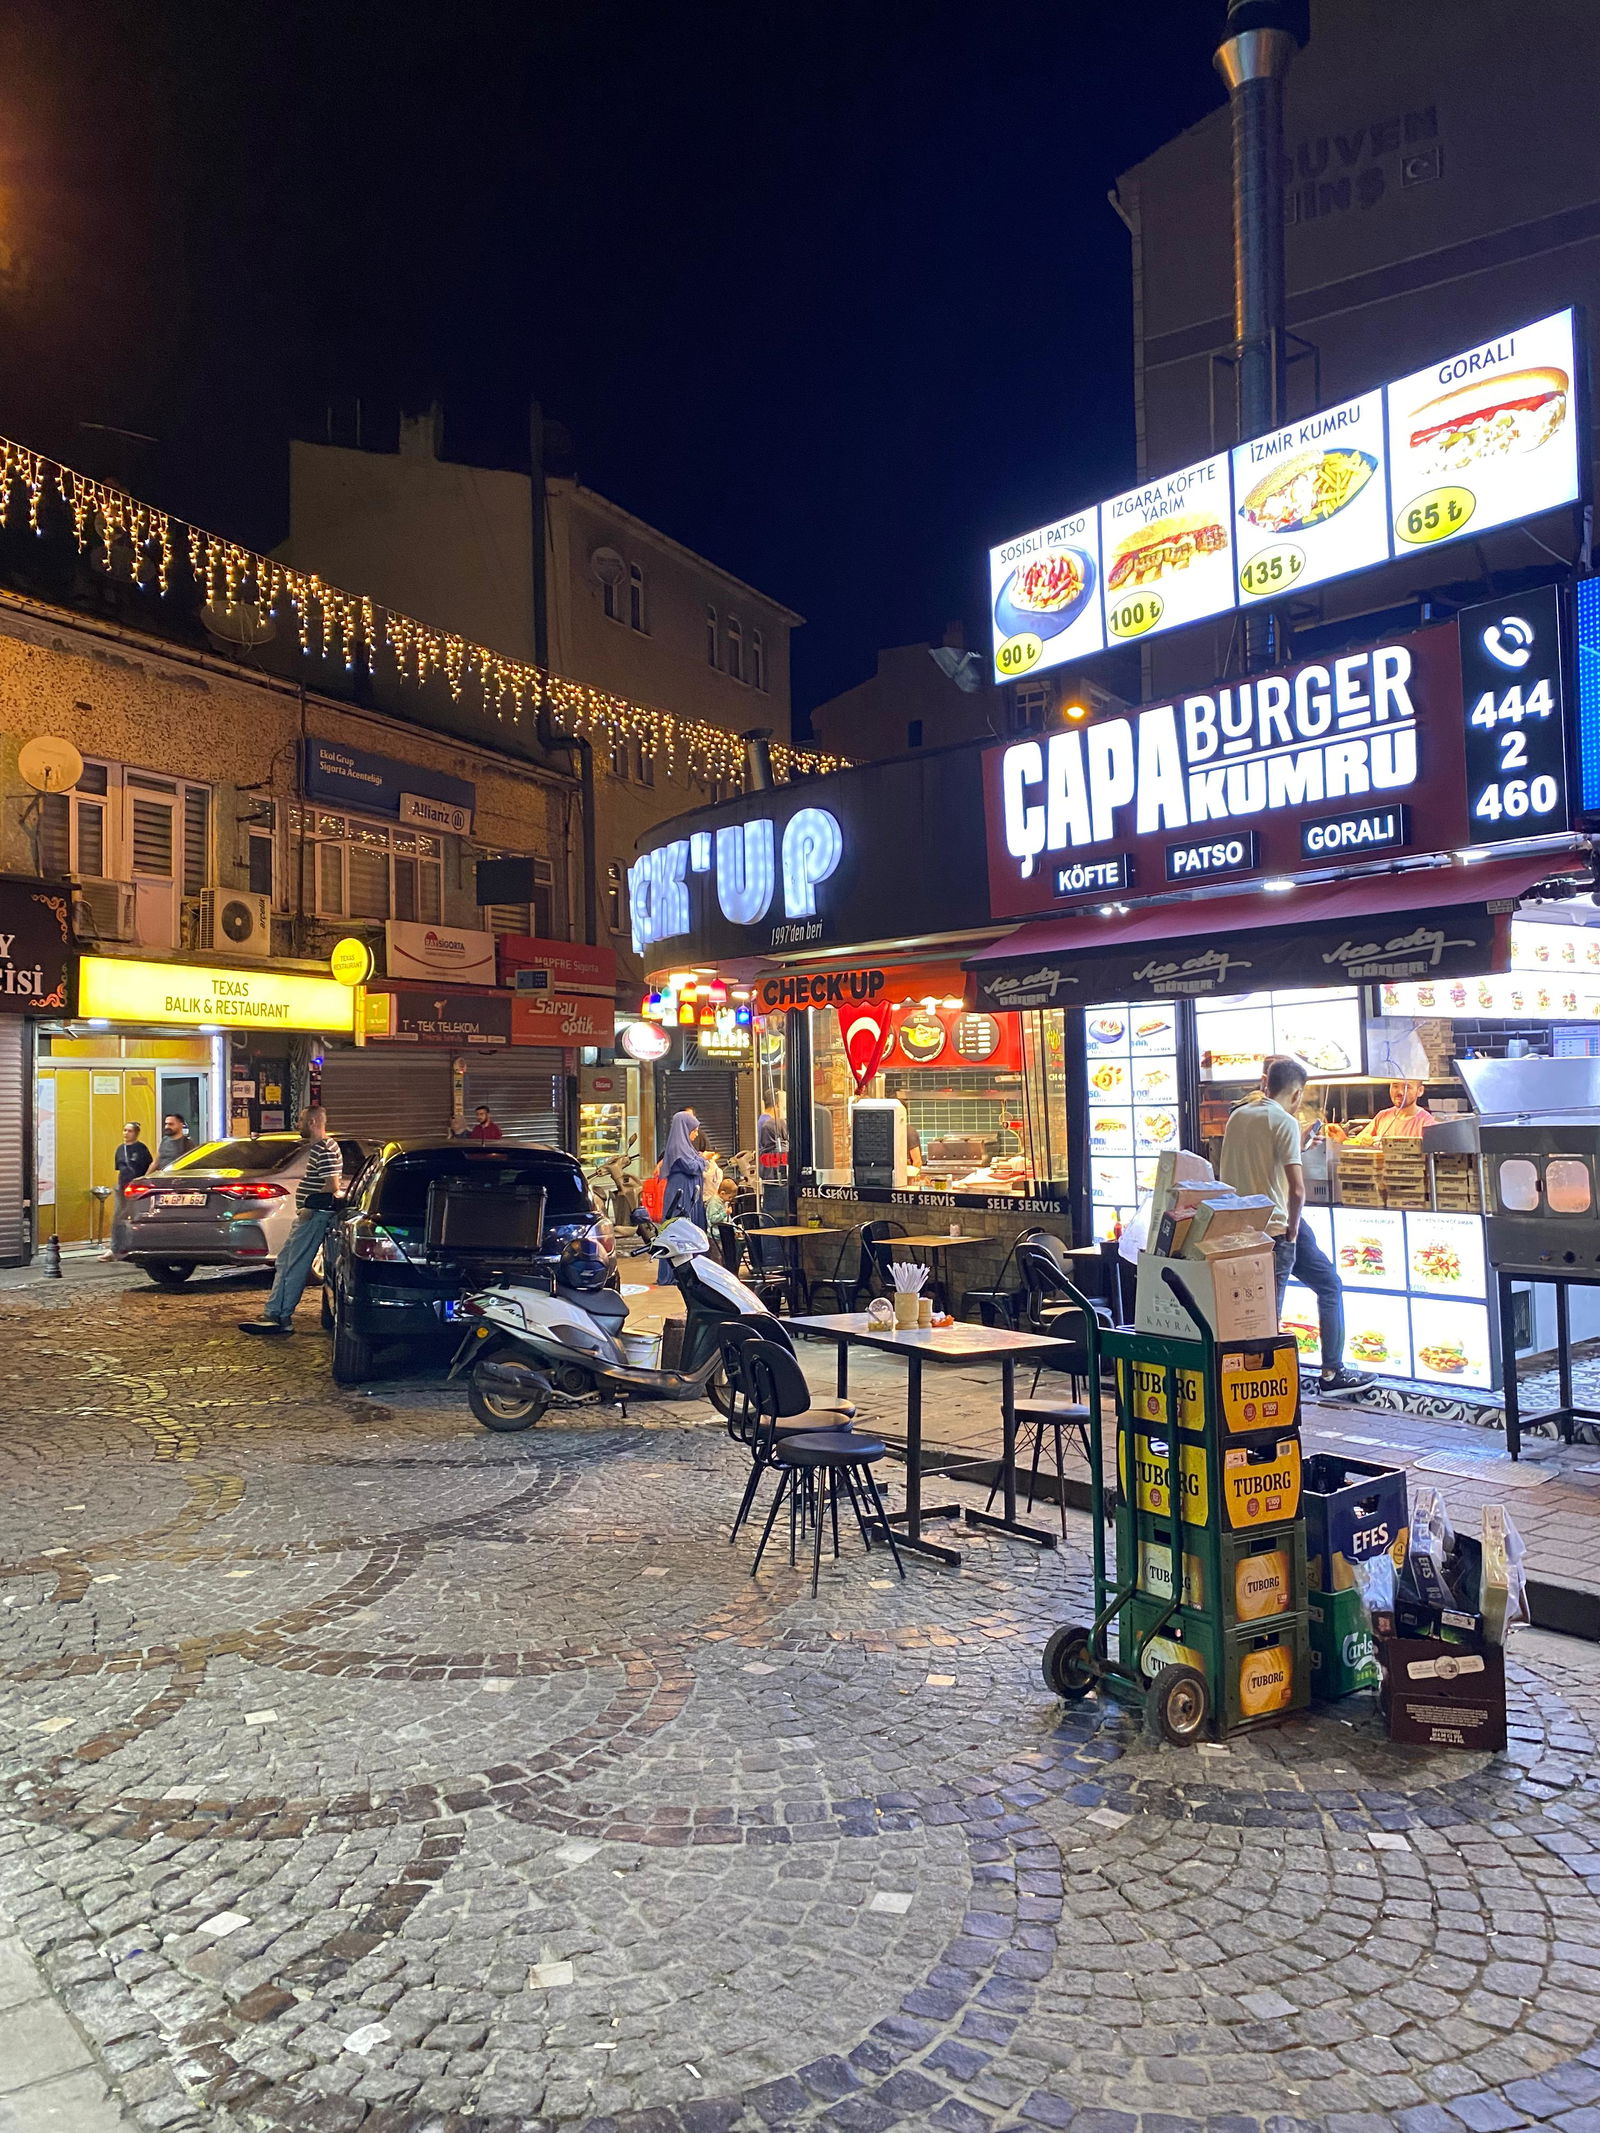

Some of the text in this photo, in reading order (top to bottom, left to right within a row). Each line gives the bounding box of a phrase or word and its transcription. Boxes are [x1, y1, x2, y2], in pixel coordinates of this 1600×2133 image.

[1439, 338, 1516, 385] GORALI
[1250, 405, 1362, 464] İZMİR KUMRU
[1111, 463, 1216, 518] IZGARA KÖFTE
[1141, 494, 1185, 524] YARIM
[1406, 504, 1441, 535] 65
[1000, 517, 1086, 564] SOSİSLİ PATSO
[1242, 556, 1284, 590] 135
[1110, 601, 1145, 631] 100
[1002, 645, 1022, 666] 90
[1187, 645, 1415, 763] BURGER
[1471, 680, 1554, 729] 444
[320, 749, 354, 767] Ekol Grup
[1501, 731, 1528, 770] 2
[320, 761, 346, 774] Sigorta
[1189, 725, 1418, 822] KUMRU
[1003, 706, 1187, 879] ÇAPA
[1476, 776, 1558, 821] 460
[413, 801, 450, 825] Allianz
[1306, 815, 1394, 851] GORALI
[1173, 841, 1244, 873] PATSO
[1058, 861, 1119, 891] KÖFTE
[805, 919, 823, 941] beri
[0, 962, 43, 995] İSİ
[212, 980, 249, 997] TEXAS
[762, 970, 884, 1006] CHECK'UP
[165, 997, 290, 1018] BALIK & RESTAURANT
[528, 998, 578, 1021] Saray
[403, 1020, 409, 1031] T
[417, 1021, 435, 1032] TEK
[437, 1022, 480, 1033] TELEKOM
[562, 1016, 593, 1036] optik
[825, 1187, 859, 1201] SERVİS
[891, 1192, 956, 1207] SELF SERVİS
[987, 1197, 1014, 1211] SELF
[1145, 1316, 1191, 1333] KAYRA
[1231, 1378, 1288, 1402] TUBORG
[1234, 1471, 1291, 1498] TUBORG
[1353, 1523, 1389, 1554] EFES
[1418, 1556, 1434, 1579] EFES
[1248, 1576, 1280, 1593] TUBORG
[1252, 1671, 1284, 1689] TUBORG
